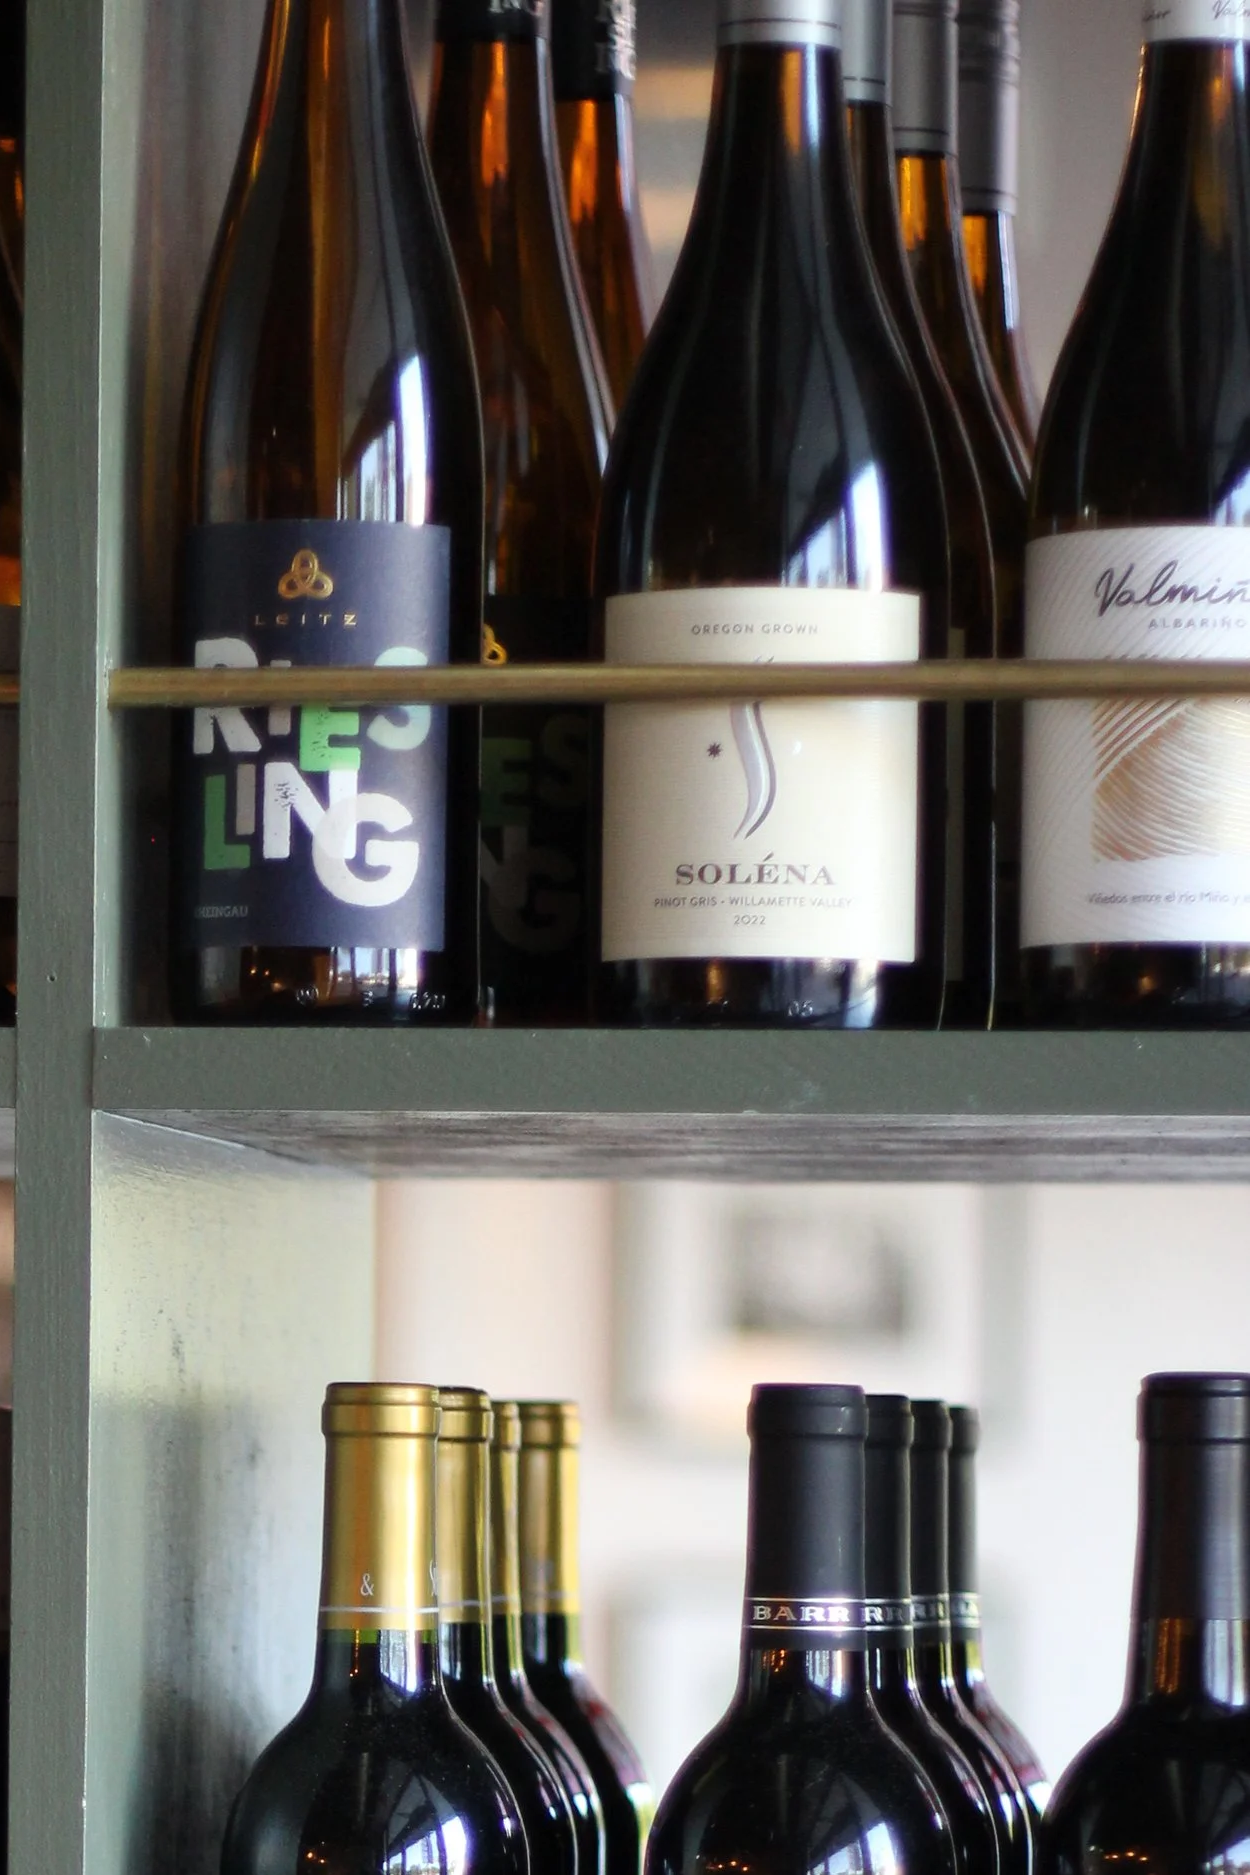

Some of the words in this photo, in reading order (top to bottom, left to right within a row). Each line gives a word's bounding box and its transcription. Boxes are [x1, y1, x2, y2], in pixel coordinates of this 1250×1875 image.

[254, 613, 358, 626] LEITZ
[1150, 617, 1247, 628] ALBARIÑO
[691, 623, 754, 635] OREGON
[761, 623, 817, 634] GROWN
[204, 762, 419, 906] LING
[676, 853, 834, 886] SOLÉNA
[654, 897, 686, 908] PINOT
[690, 896, 717, 907] GRIS
[729, 896, 804, 907] WILLAMETTE
[812, 898, 852, 909] VALLEY
[734, 915, 766, 925] 2022
[753, 1605, 849, 1622] BARR
